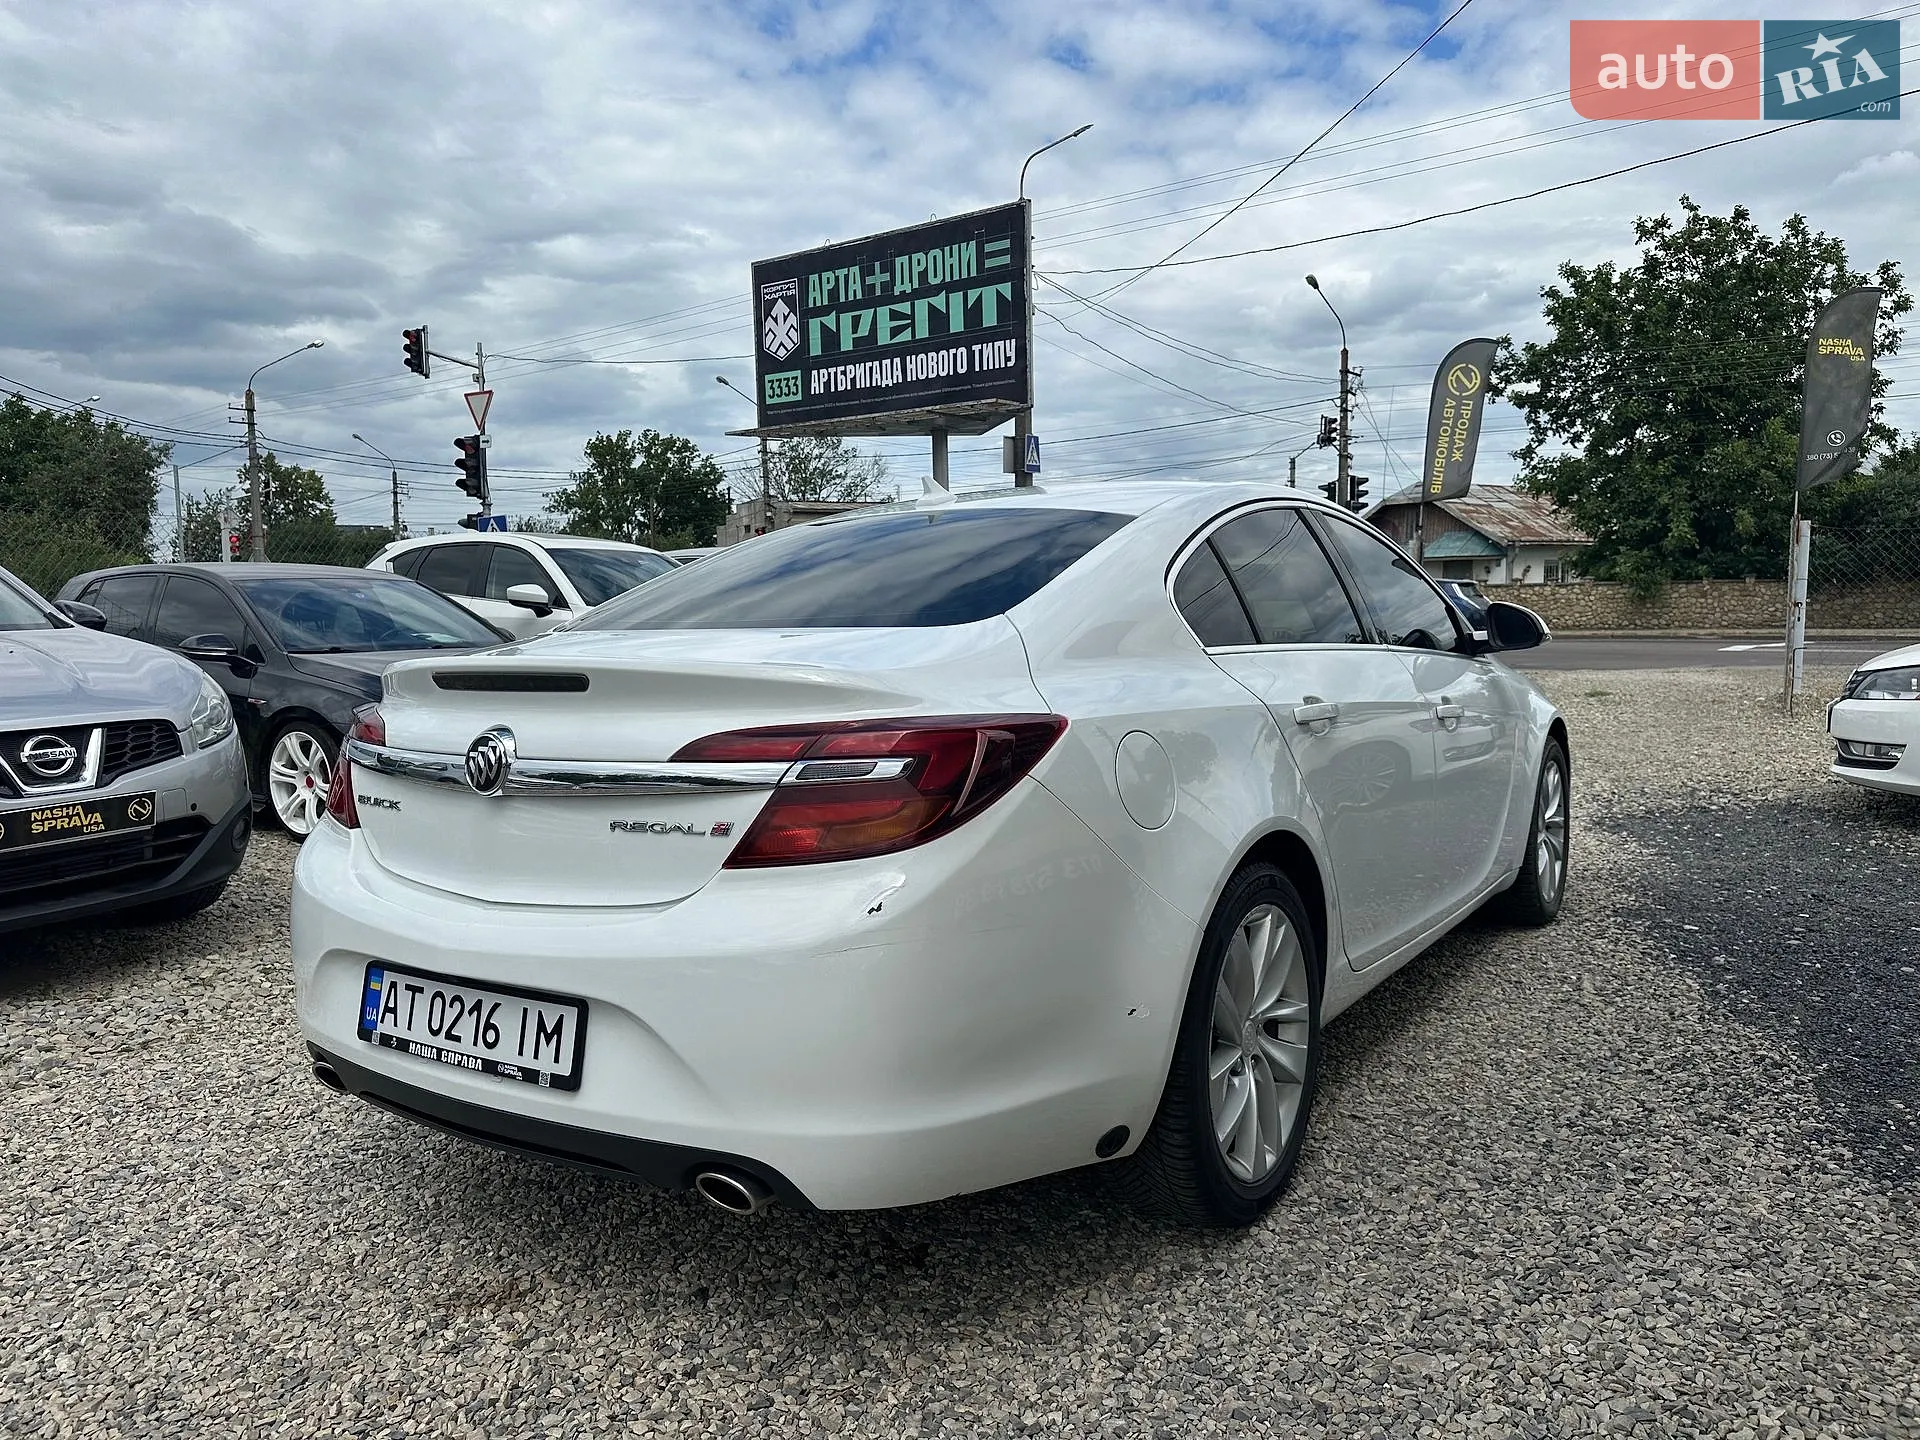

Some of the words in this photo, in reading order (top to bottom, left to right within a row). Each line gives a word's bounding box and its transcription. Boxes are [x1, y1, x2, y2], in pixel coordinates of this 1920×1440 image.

[763, 282, 796, 293] КОРПУС
[763, 289, 796, 300] ХАРТІЯ
[1818, 345, 1864, 356] SPRAVA
[1819, 338, 1852, 347] NASHA
[810, 357, 902, 395] АРТБРИГАДА
[906, 347, 968, 382] НОВОГО
[972, 338, 1017, 372] ТИПУ
[767, 375, 799, 400] 3333
[1451, 400, 1474, 462] ПРОДАЖ
[1430, 398, 1457, 494] АВТОМОБІЛІВ
[27, 748, 73, 761] NISSAN
[357, 794, 402, 811] BUICK
[31, 805, 83, 821] NASHA
[31, 812, 103, 833] SPRAVA
[83, 822, 105, 833] USA
[609, 820, 706, 836] REGAL
[366, 1007, 377, 1022] UA
[379, 980, 425, 1031] AT
[427, 990, 502, 1050] 0216
[517, 1006, 565, 1064] IM
[408, 1041, 437, 1060] НАША
[440, 1050, 483, 1071] СПРАВА
